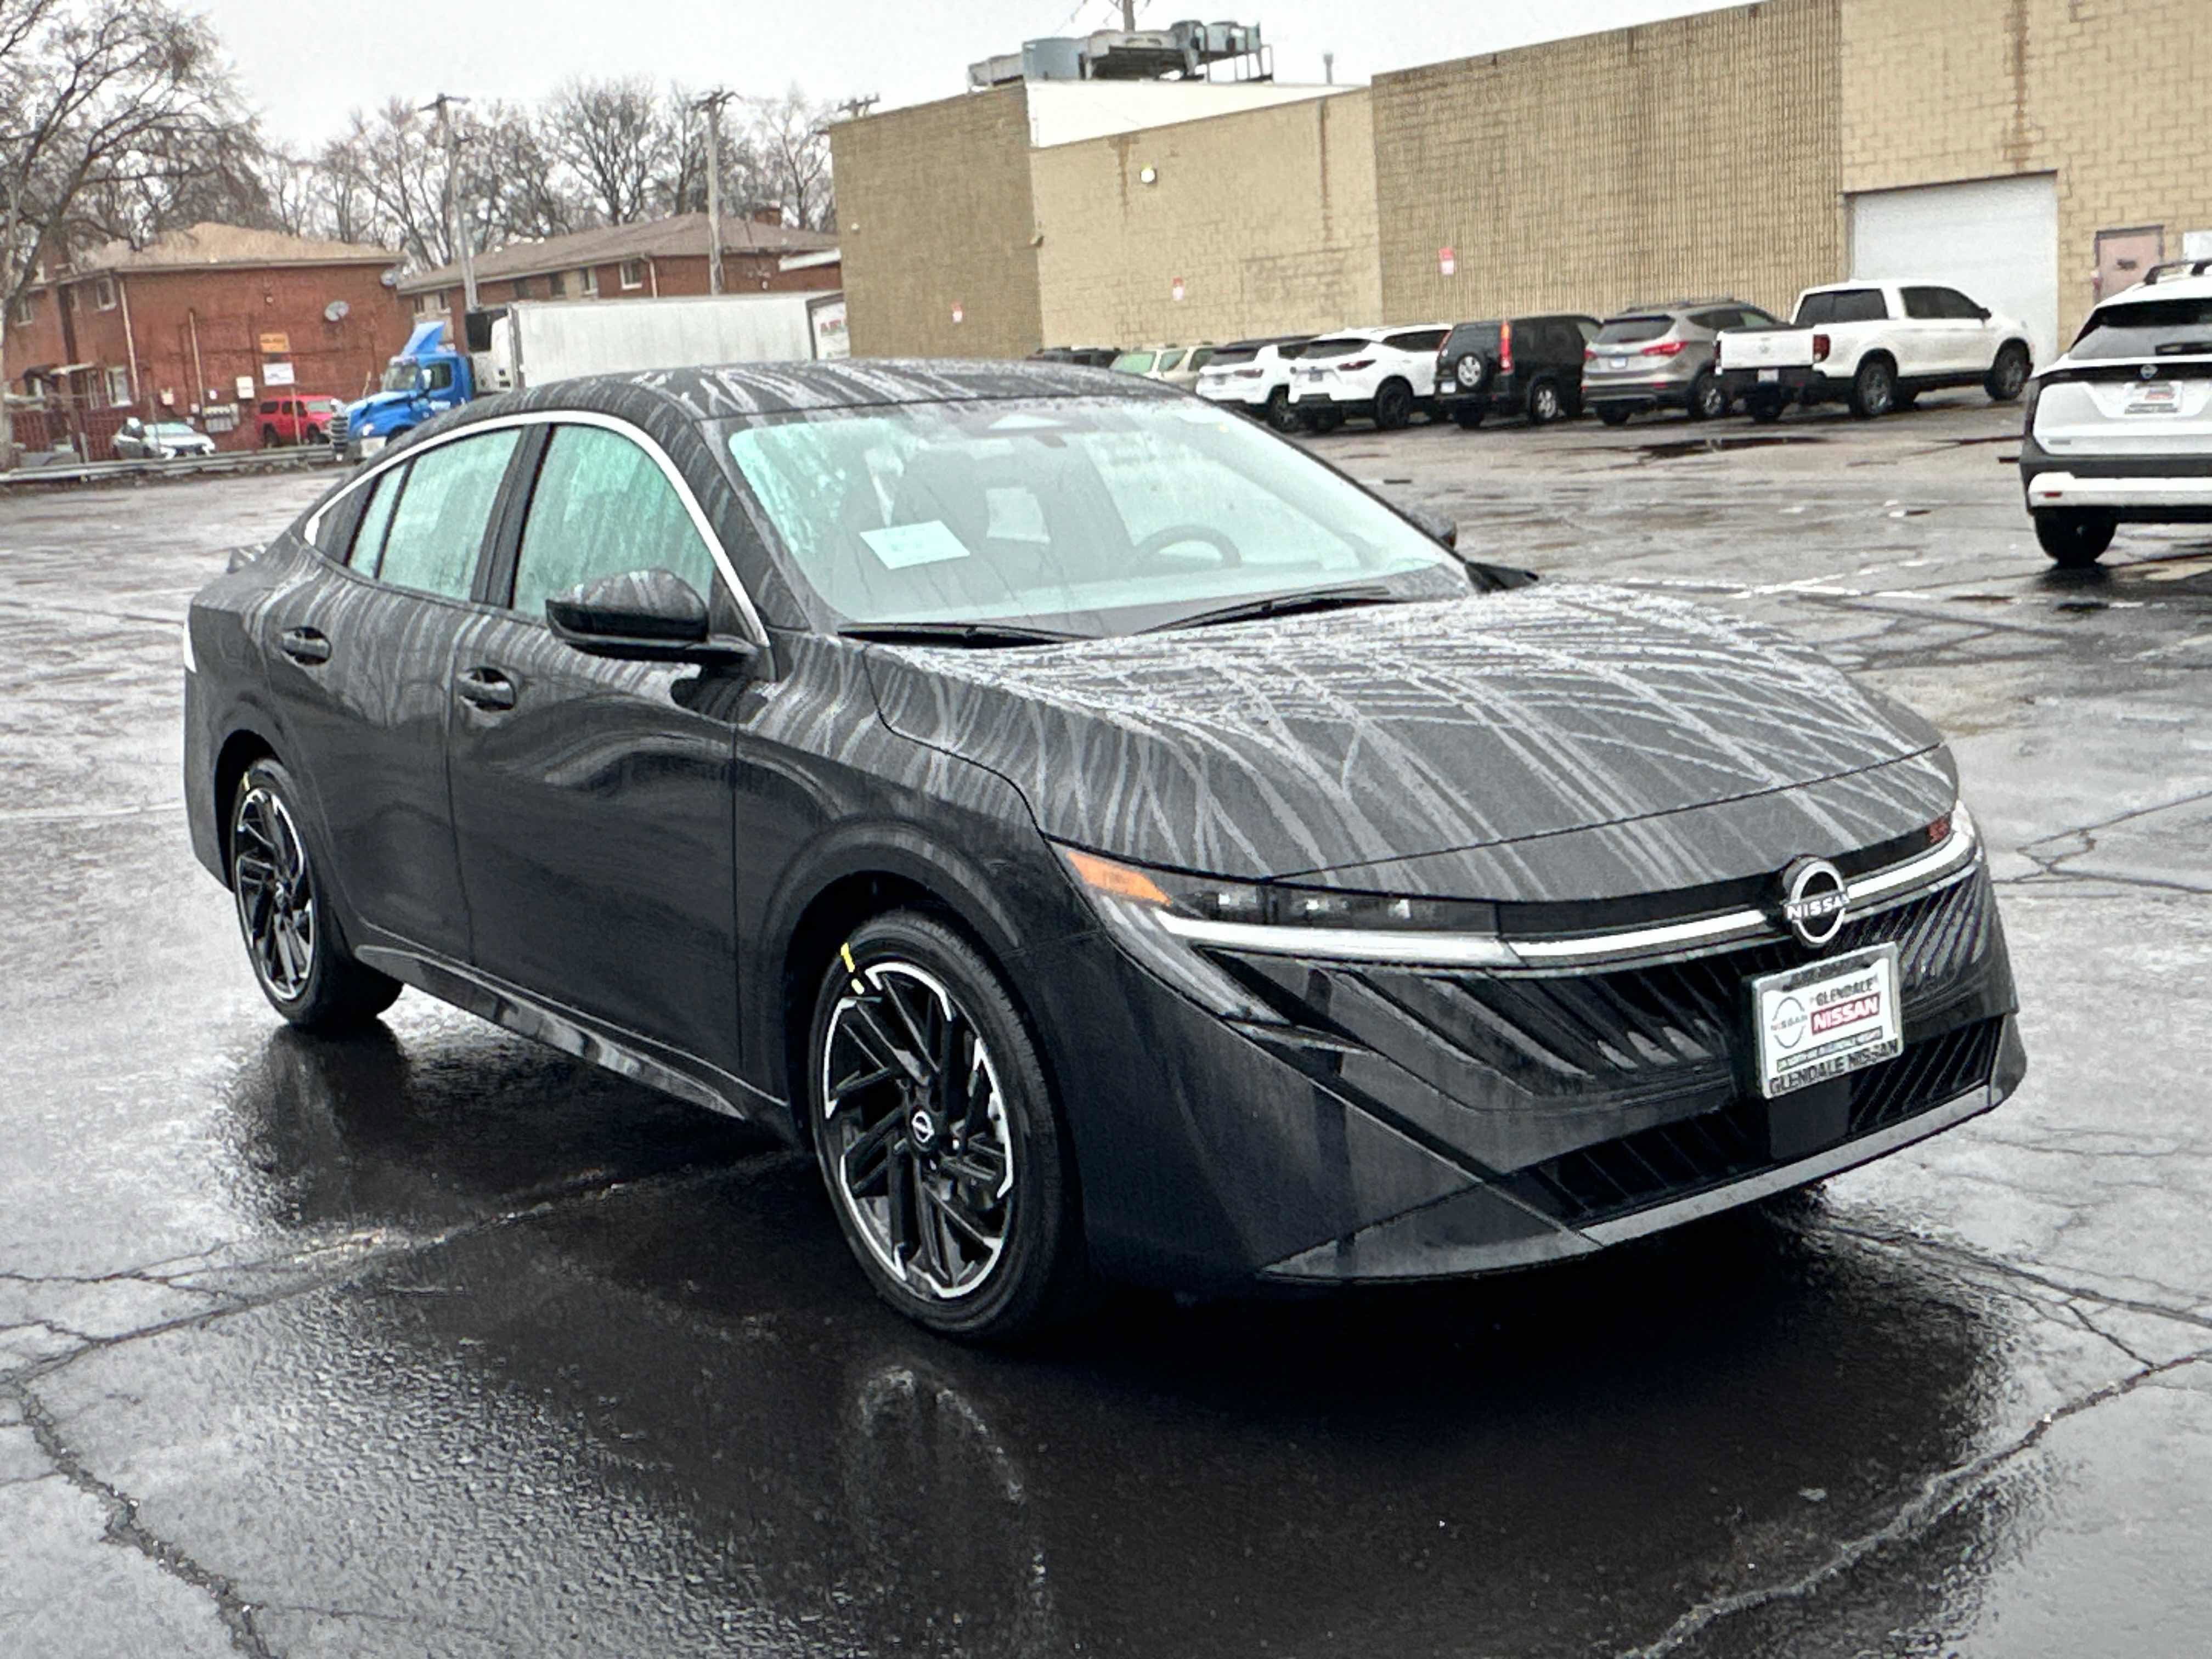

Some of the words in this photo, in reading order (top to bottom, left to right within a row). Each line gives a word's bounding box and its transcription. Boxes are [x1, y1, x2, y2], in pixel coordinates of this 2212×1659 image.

[1815, 977, 1874, 1006] GLENDALE
[1771, 1015, 1808, 1031] NISSAN
[1813, 997, 1878, 1032] NISSAN
[1769, 1056, 1844, 1094] GLENDALE
[1847, 1039, 1898, 1068] NISSAN
